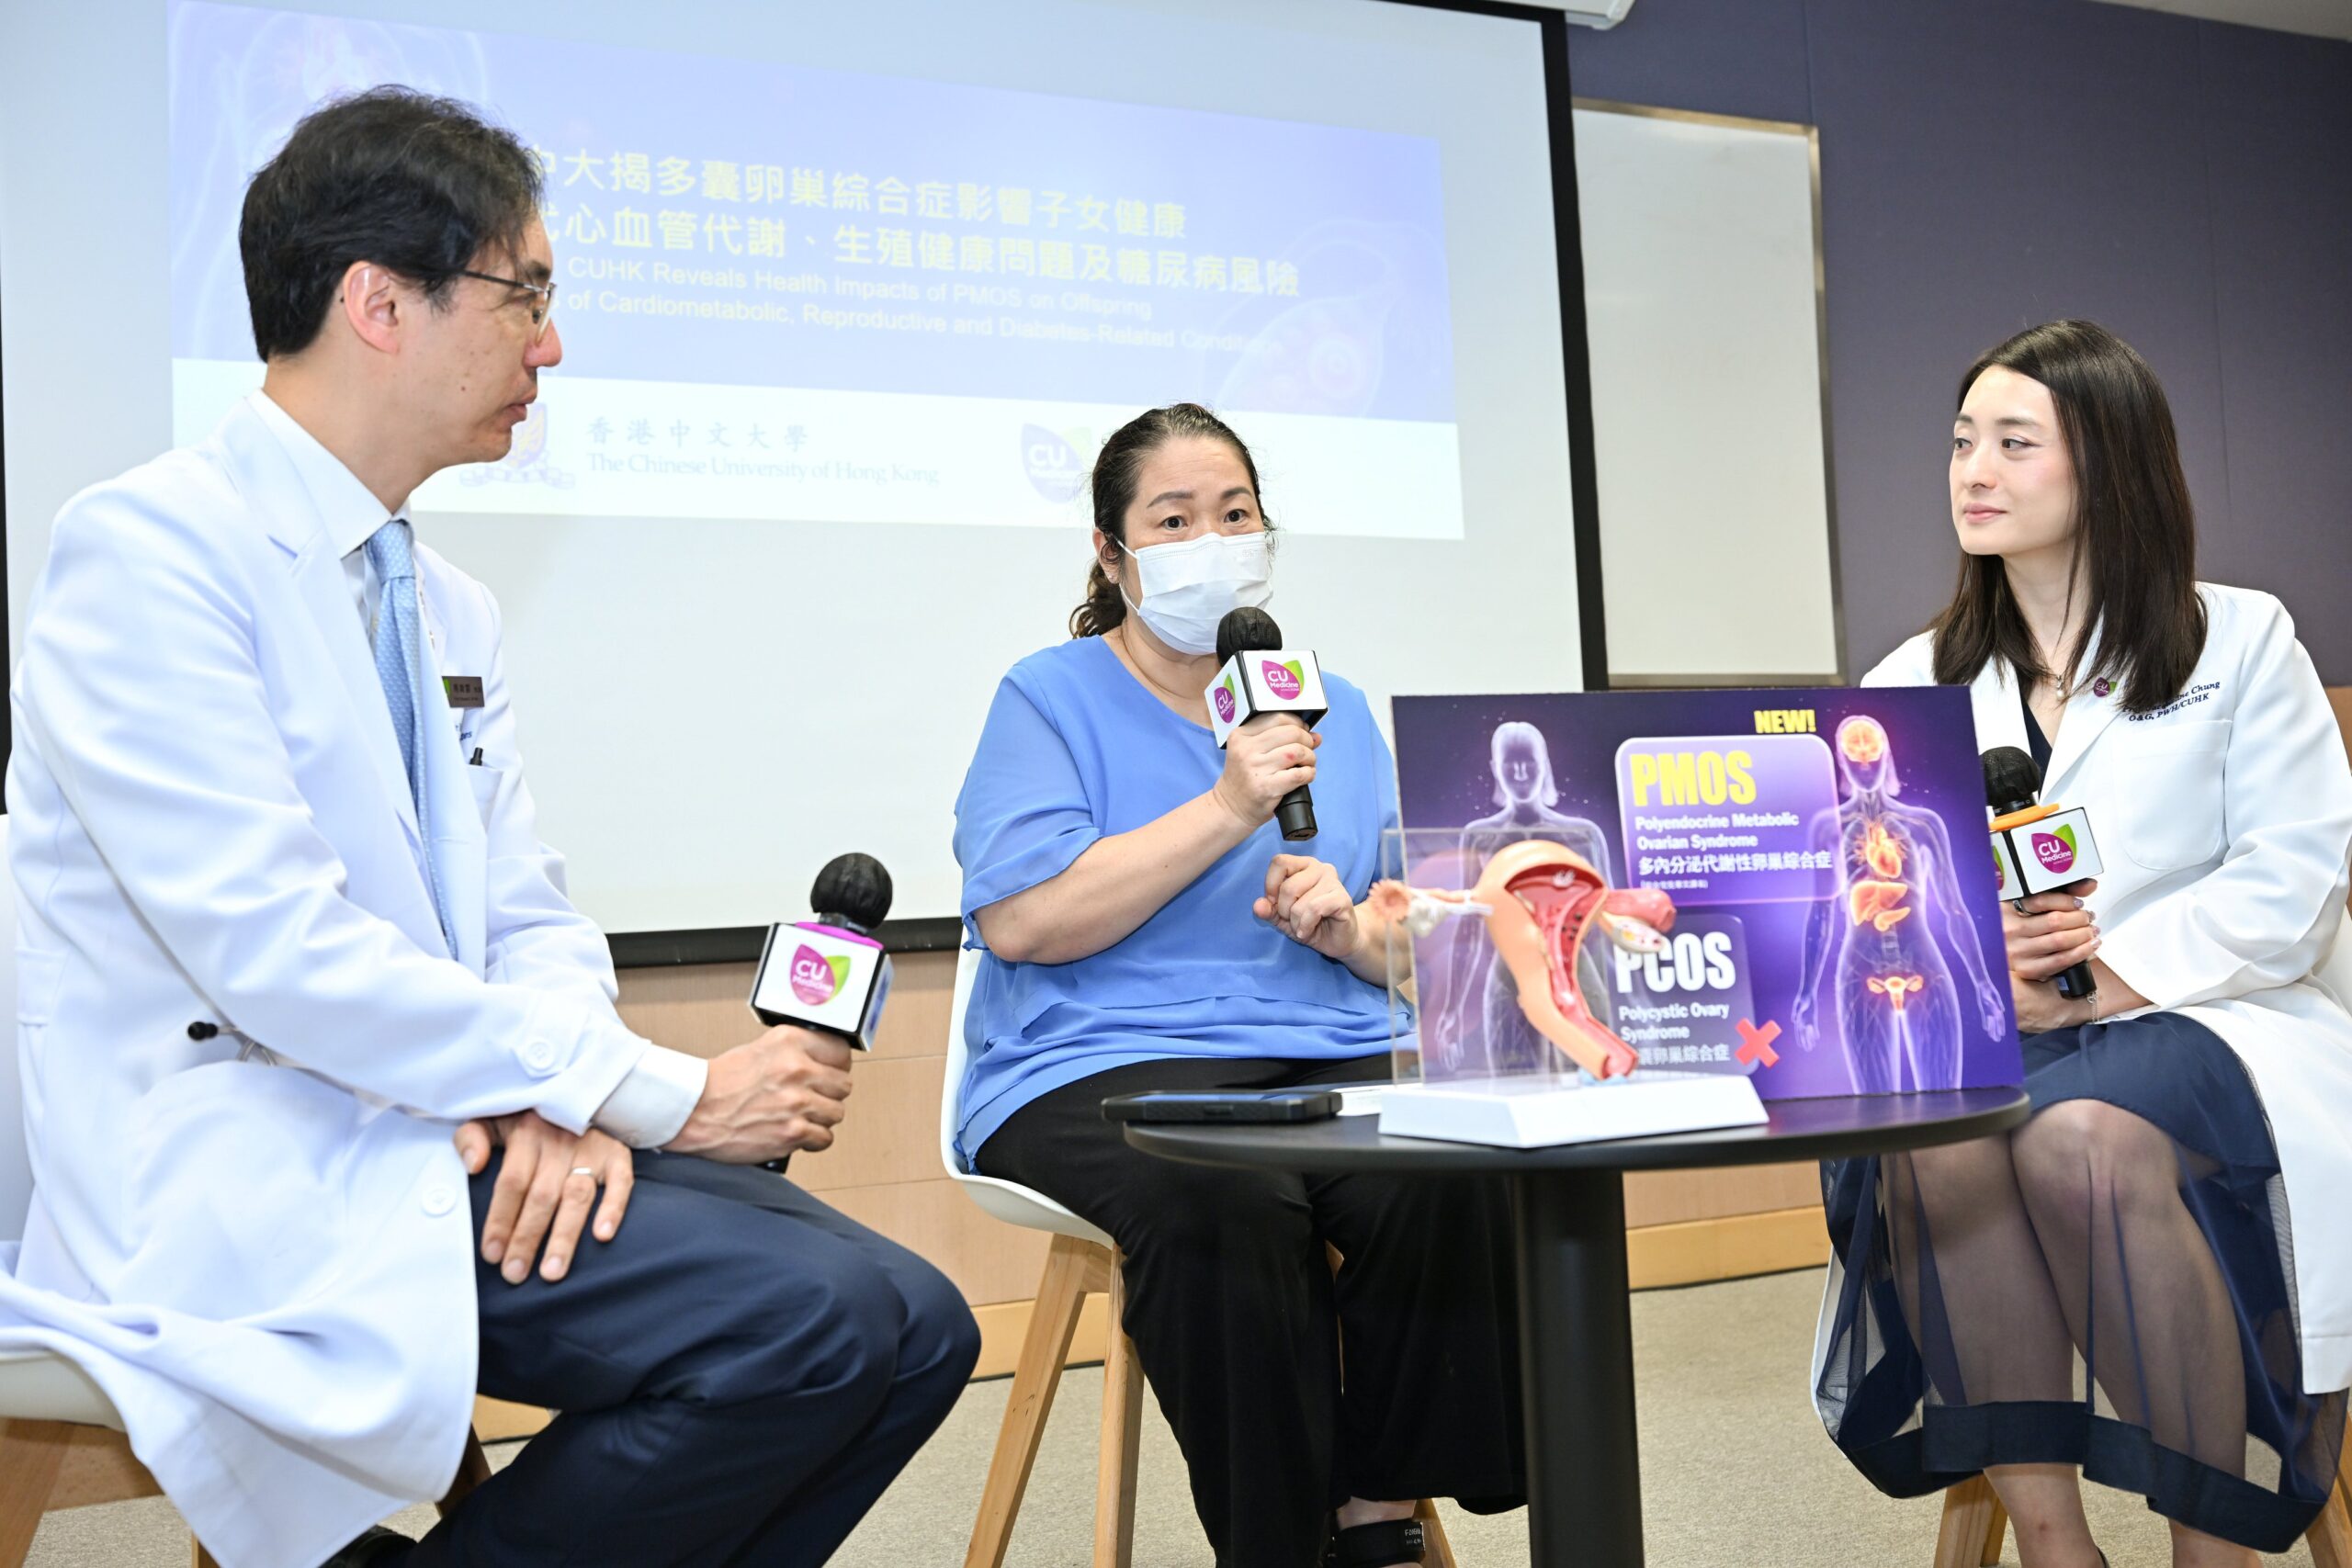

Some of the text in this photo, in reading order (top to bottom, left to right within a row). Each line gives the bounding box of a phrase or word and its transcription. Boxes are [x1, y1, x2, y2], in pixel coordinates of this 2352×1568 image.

[568, 256, 1153, 321] CUHK Reveals Health Impacts of PMOS on Offspring
[567, 289, 593, 312] of
[598, 289, 795, 325] Cardiometabolic,
[802, 302, 948, 333] Reproductive
[953, 313, 993, 337] and
[999, 316, 1175, 349] Diabetes-Related
[1181, 329, 1284, 356] Condit
[585, 416, 809, 452] 香港中文大學
[1028, 444, 1068, 468] CU
[586, 451, 942, 488] The Chinese University of Hong Kong
[1267, 670, 1289, 682] CU
[2190, 681, 2221, 694] Chung
[1217, 690, 1228, 710] CU
[2129, 693, 2210, 722] O&G, PWH/CUHK
[1754, 709, 1816, 734] NEW!
[1630, 750, 1757, 807] PMOS
[1634, 811, 1800, 833] Polyendocrine Metabolic
[1636, 833, 1758, 852] Ovarian Syndrome
[2038, 839, 2061, 857] CU
[2041, 851, 2072, 864] Medicine
[796, 959, 827, 981] CU
[1613, 931, 1736, 993] PCOS
[1618, 1002, 1729, 1022] Polycystic Ovary
[1620, 1026, 1690, 1043] Syndrome
[1638, 1043, 1731, 1066] 囊卵巢綜合症
